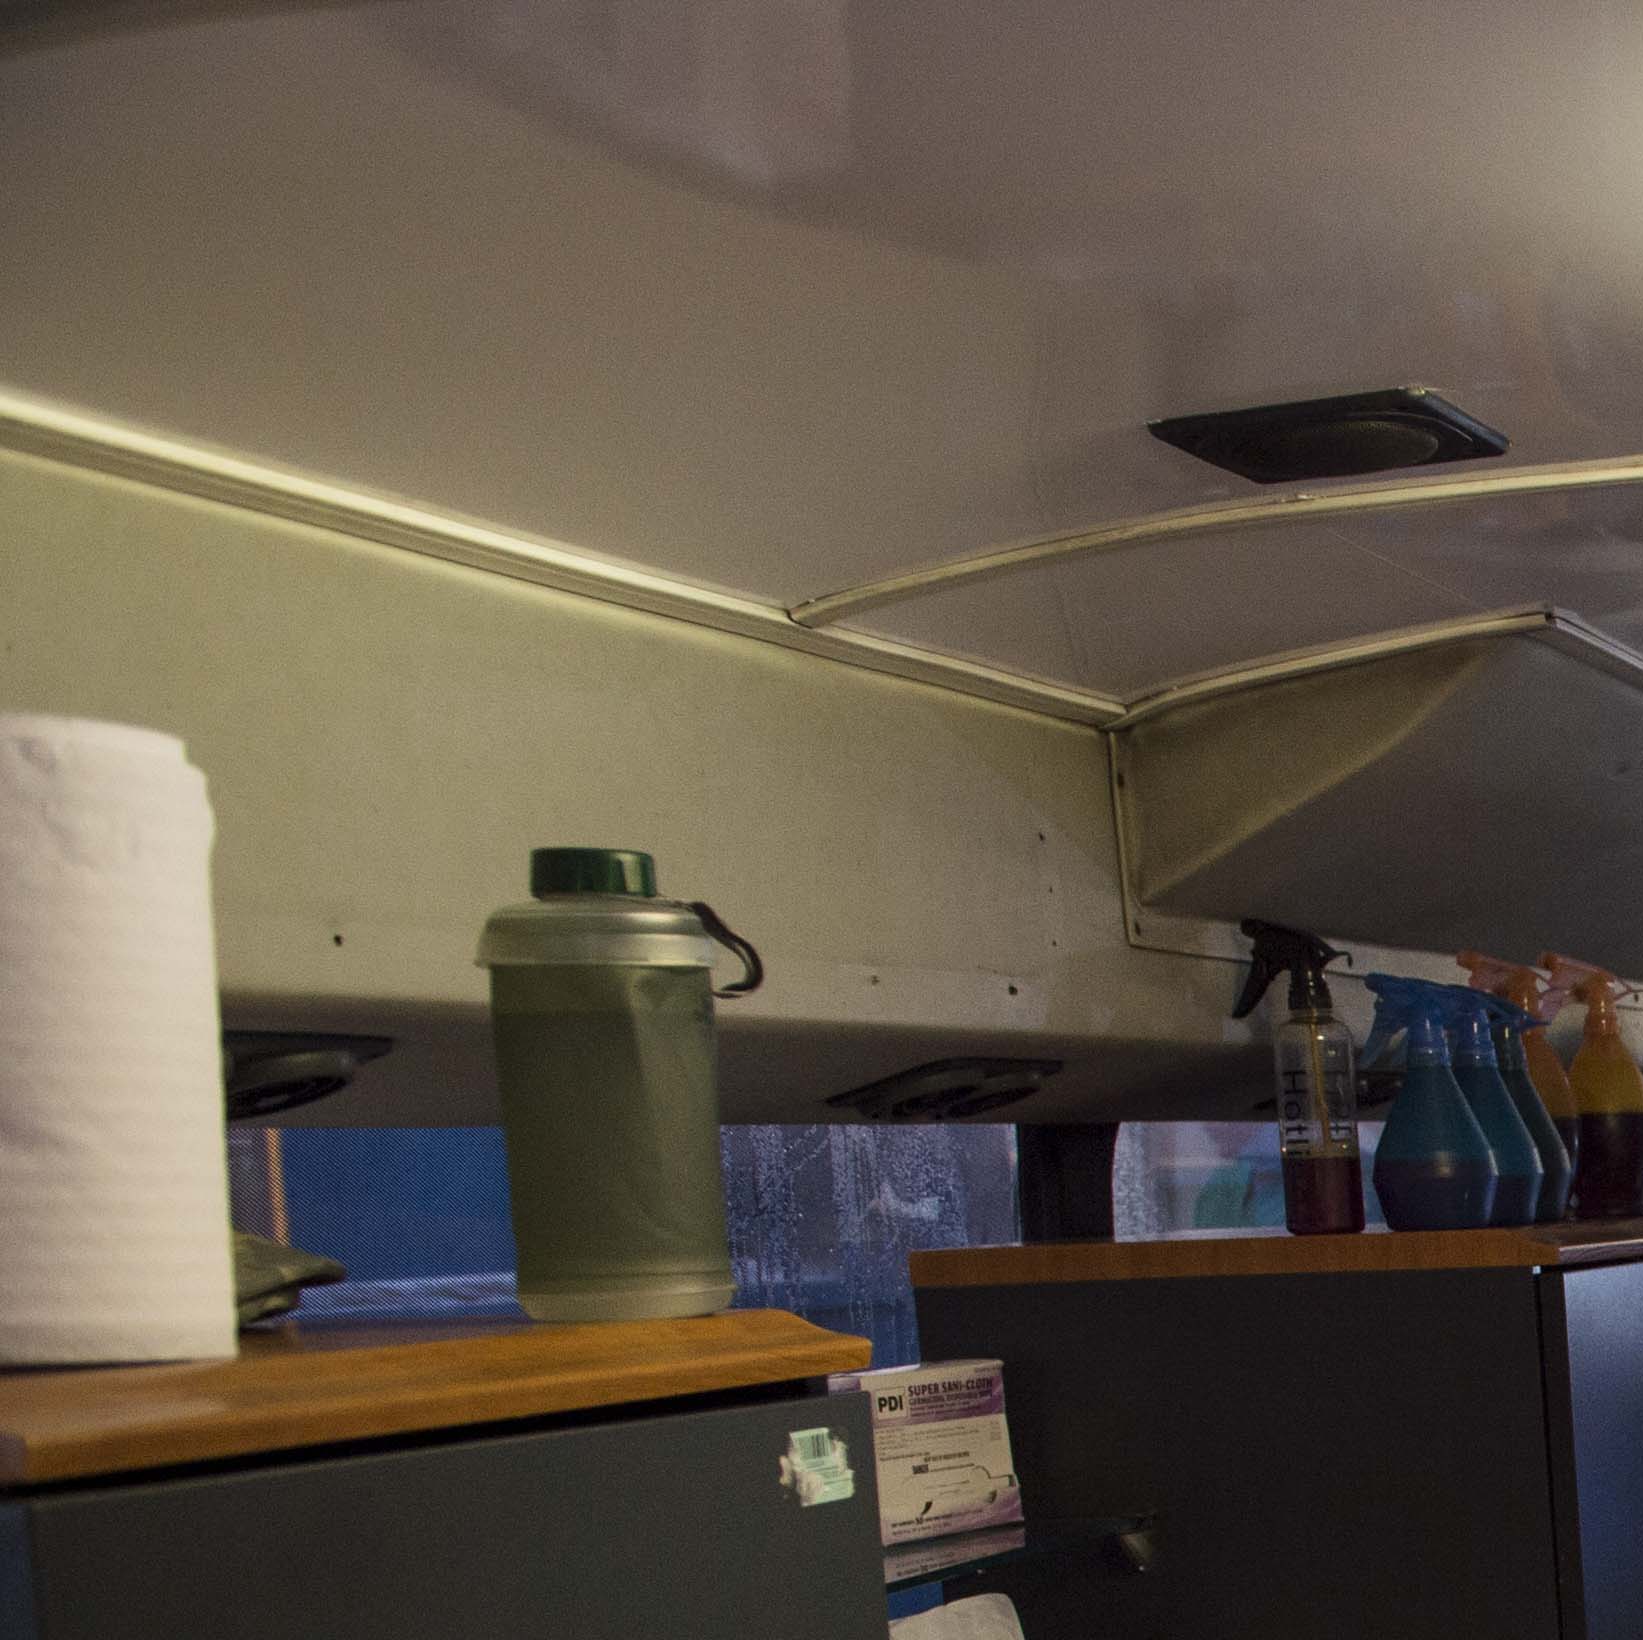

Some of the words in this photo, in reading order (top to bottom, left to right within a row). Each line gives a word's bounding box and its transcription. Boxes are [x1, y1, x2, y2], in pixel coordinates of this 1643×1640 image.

[908, 1383, 939, 1397] SUPER
[941, 1377, 993, 1394] SANI-CLOTH
[878, 1394, 903, 1413] PDI
